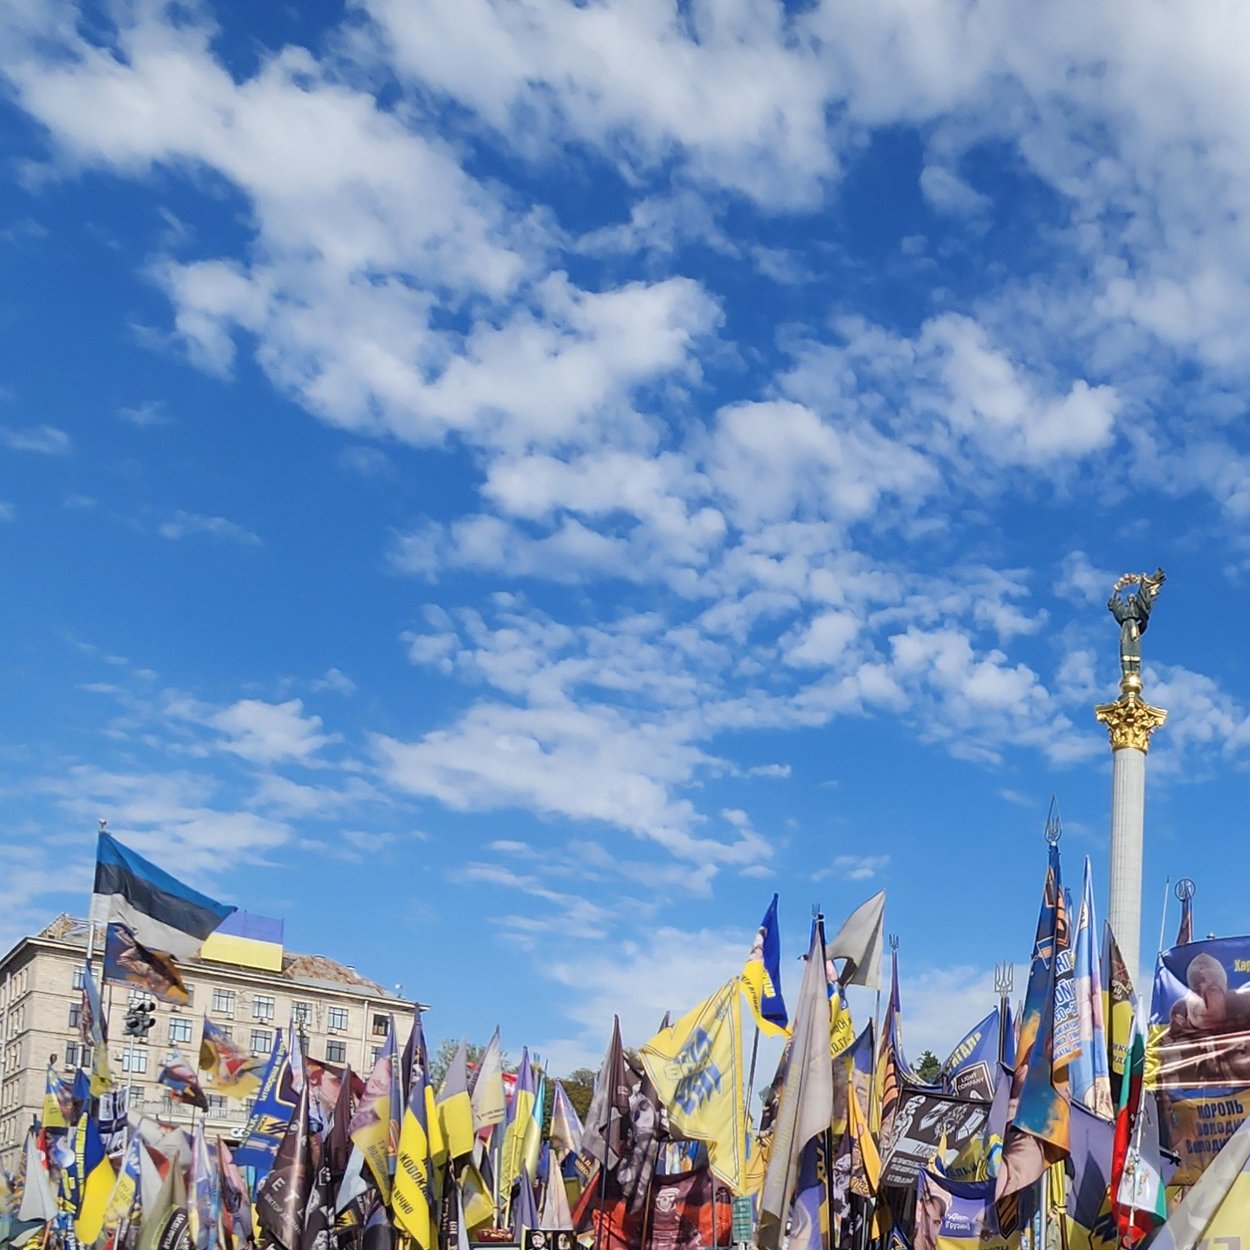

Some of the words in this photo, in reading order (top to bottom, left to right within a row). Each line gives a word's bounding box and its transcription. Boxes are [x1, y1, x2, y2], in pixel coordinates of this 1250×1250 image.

[957, 1077, 984, 1091] COMPANY
[961, 1071, 978, 1083] LIGHT
[1196, 1099, 1244, 1119] КОРОЛЬ
